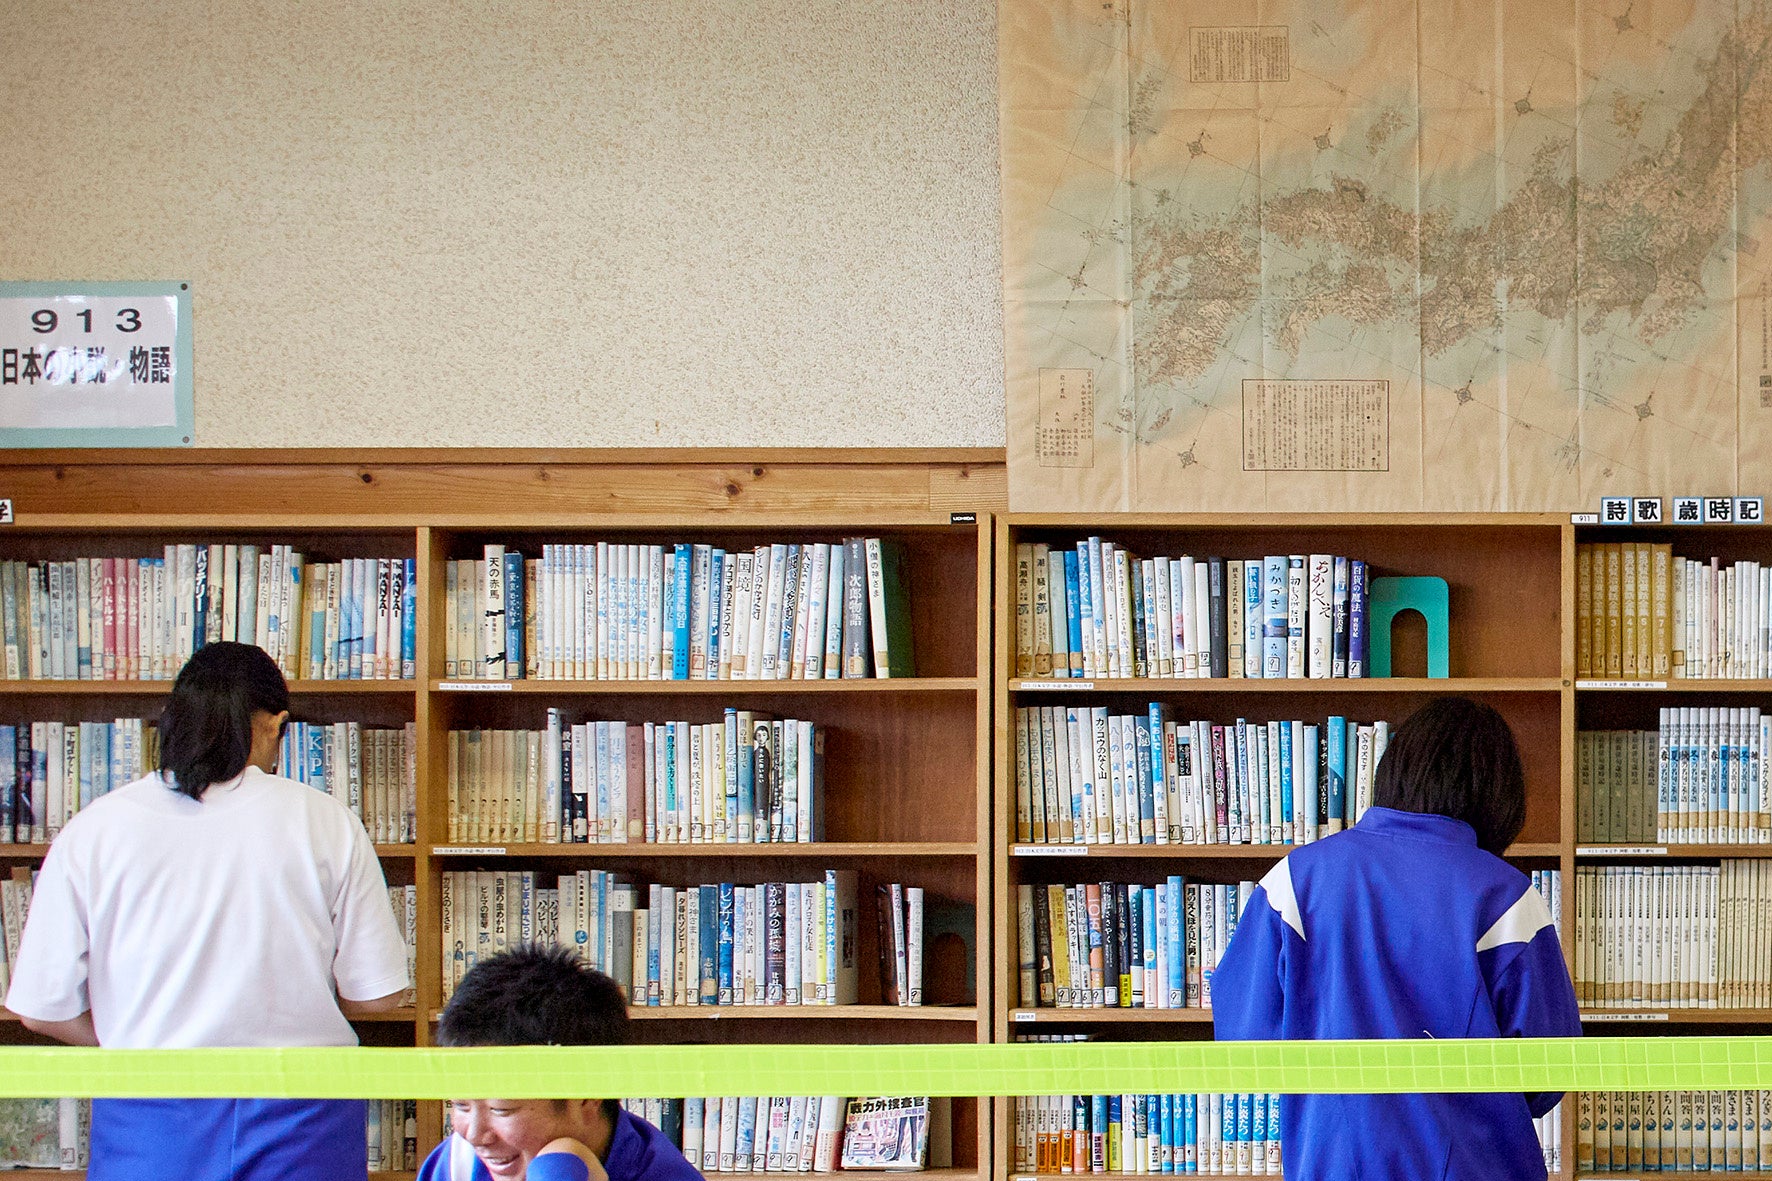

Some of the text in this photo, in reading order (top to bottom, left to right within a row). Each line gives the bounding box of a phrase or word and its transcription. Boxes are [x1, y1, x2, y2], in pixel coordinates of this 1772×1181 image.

[31, 308, 142, 333] 913
[129, 345, 170, 384] 物語
[1606, 500, 1658, 521] 詩歌
[1678, 500, 1759, 521] 歳時記
[196, 549, 209, 612] バッテリー
[378, 572, 389, 617] MANZAI
[391, 572, 402, 618] MANZAI
[489, 557, 500, 600] 天の赤馬
[849, 574, 863, 627] 次郎物語
[1269, 563, 1282, 610] みかづき
[1311, 560, 1331, 619] あかんべえ
[1351, 565, 1362, 613] 百貨の魔法
[1095, 717, 1108, 781] カッコウのなく山
[769, 885, 783, 953] かがみの孤城
[1102, 885, 1113, 944] 怪物はささやく
[1187, 887, 1197, 956] 月のえくぼを見た男
[850, 1096, 925, 1115] 戦力外捜査官
